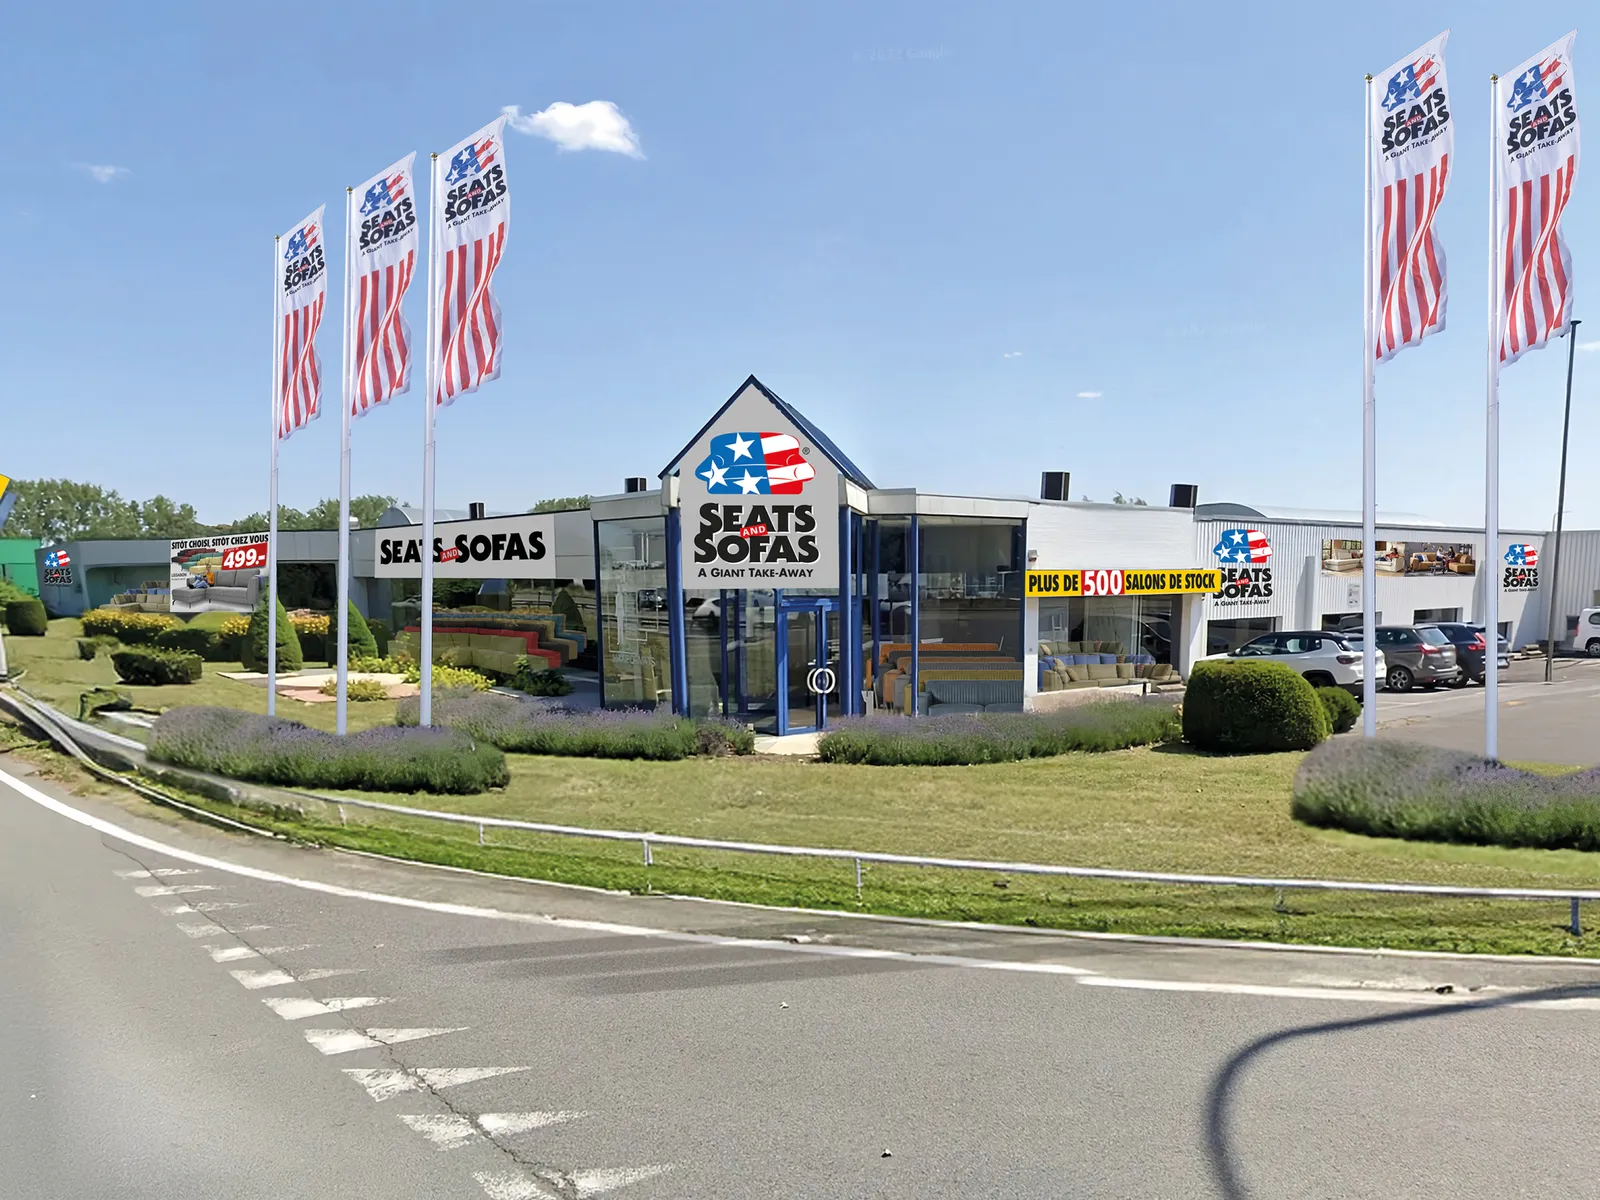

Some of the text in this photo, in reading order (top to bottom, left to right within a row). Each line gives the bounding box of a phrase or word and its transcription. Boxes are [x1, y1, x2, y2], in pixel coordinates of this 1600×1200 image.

[1384, 87, 1445, 136] SEATS
[1406, 115, 1421, 126] AND
[1509, 88, 1572, 137] SEATS
[1532, 116, 1548, 127] AND
[1382, 105, 1449, 154] SOFAS
[1390, 146, 1410, 158] GIANT
[1411, 126, 1448, 149] TAKE-AWAY
[1507, 106, 1576, 155] SOFAS
[1516, 147, 1535, 159] GIANT
[1537, 127, 1574, 150] TAKE-AWAY
[445, 179, 506, 223] SOFAS
[447, 164, 503, 208] SEATS
[467, 188, 482, 198] AND
[359, 211, 415, 250] SOFAS
[361, 197, 412, 237] SEATS
[452, 215, 470, 226] GIANT
[284, 257, 325, 292] SOFAS
[286, 245, 322, 280] SEATS
[699, 503, 816, 535] SEATS
[742, 525, 767, 538] AND
[171, 540, 188, 549] SITÔT
[212, 537, 230, 546] SITÔT
[231, 535, 249, 545] CHEZ
[250, 534, 269, 543] VOUS
[441, 548, 458, 561] AND
[455, 531, 546, 563] SOFAS
[694, 535, 820, 563] SOFAS
[44, 576, 72, 584] SOFAS
[45, 568, 71, 577] SEATS
[698, 568, 814, 578] A GIANT TAKE-AWAY
[1029, 570, 1215, 595] PLUS DE 500 SALONS DE STOCK
[1503, 578, 1539, 587] SOFAS
[1505, 567, 1538, 578] SEATS
